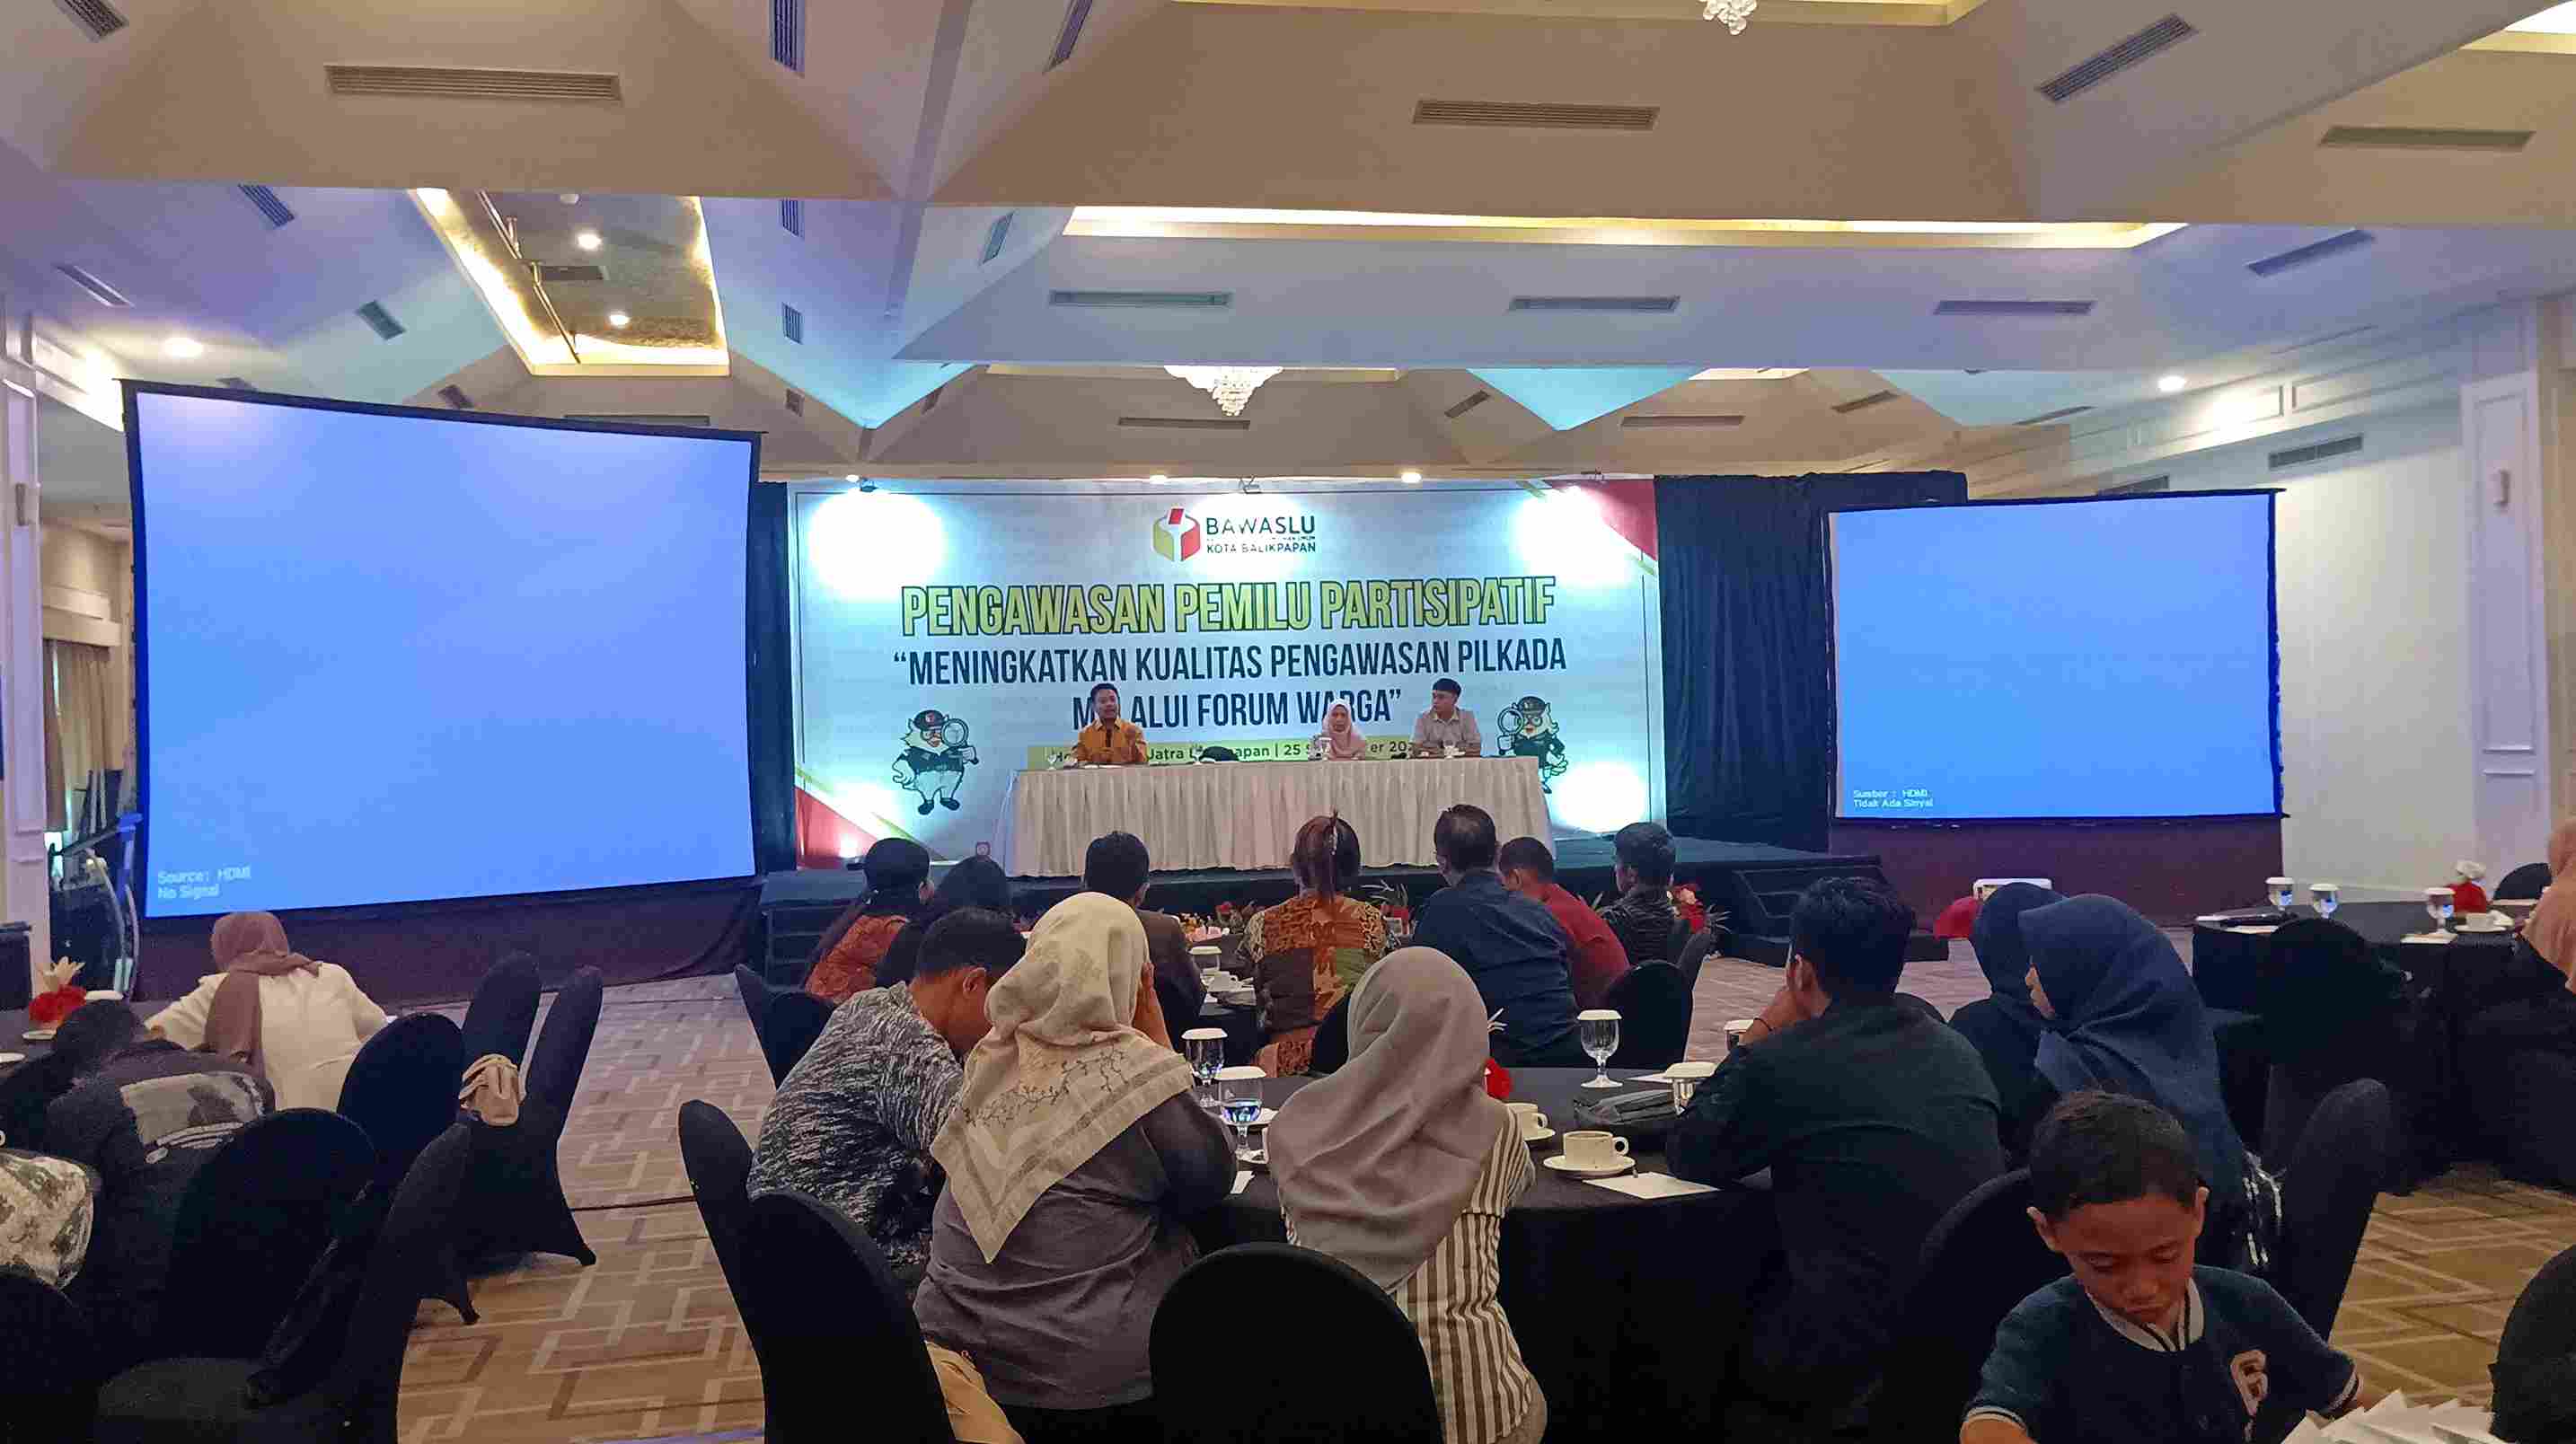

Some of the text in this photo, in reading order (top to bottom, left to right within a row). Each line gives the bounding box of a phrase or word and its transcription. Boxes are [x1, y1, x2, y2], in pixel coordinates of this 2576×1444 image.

[1206, 515, 1316, 535] BAWASLU
[1206, 542, 1316, 554] KOTA BALIKPAPAN
[901, 576, 1556, 637] PENGAWASAN PEMILU PARTISIPATIF
[1135, 644, 1264, 683] KUALITAS
[1271, 640, 1449, 678] PENGAWASAN
[1458, 637, 1567, 673] PILKADA
[1073, 694, 1188, 731] MALUI
[1198, 691, 1288, 727] FORUM
[1148, 747, 1184, 761] Jatra
[1284, 744, 1301, 756] 25
[1853, 799, 1879, 808] Tidak
[1882, 798, 1902, 808] Ada
[217, 866, 251, 881] HDMI
[157, 884, 220, 900] No Signal
